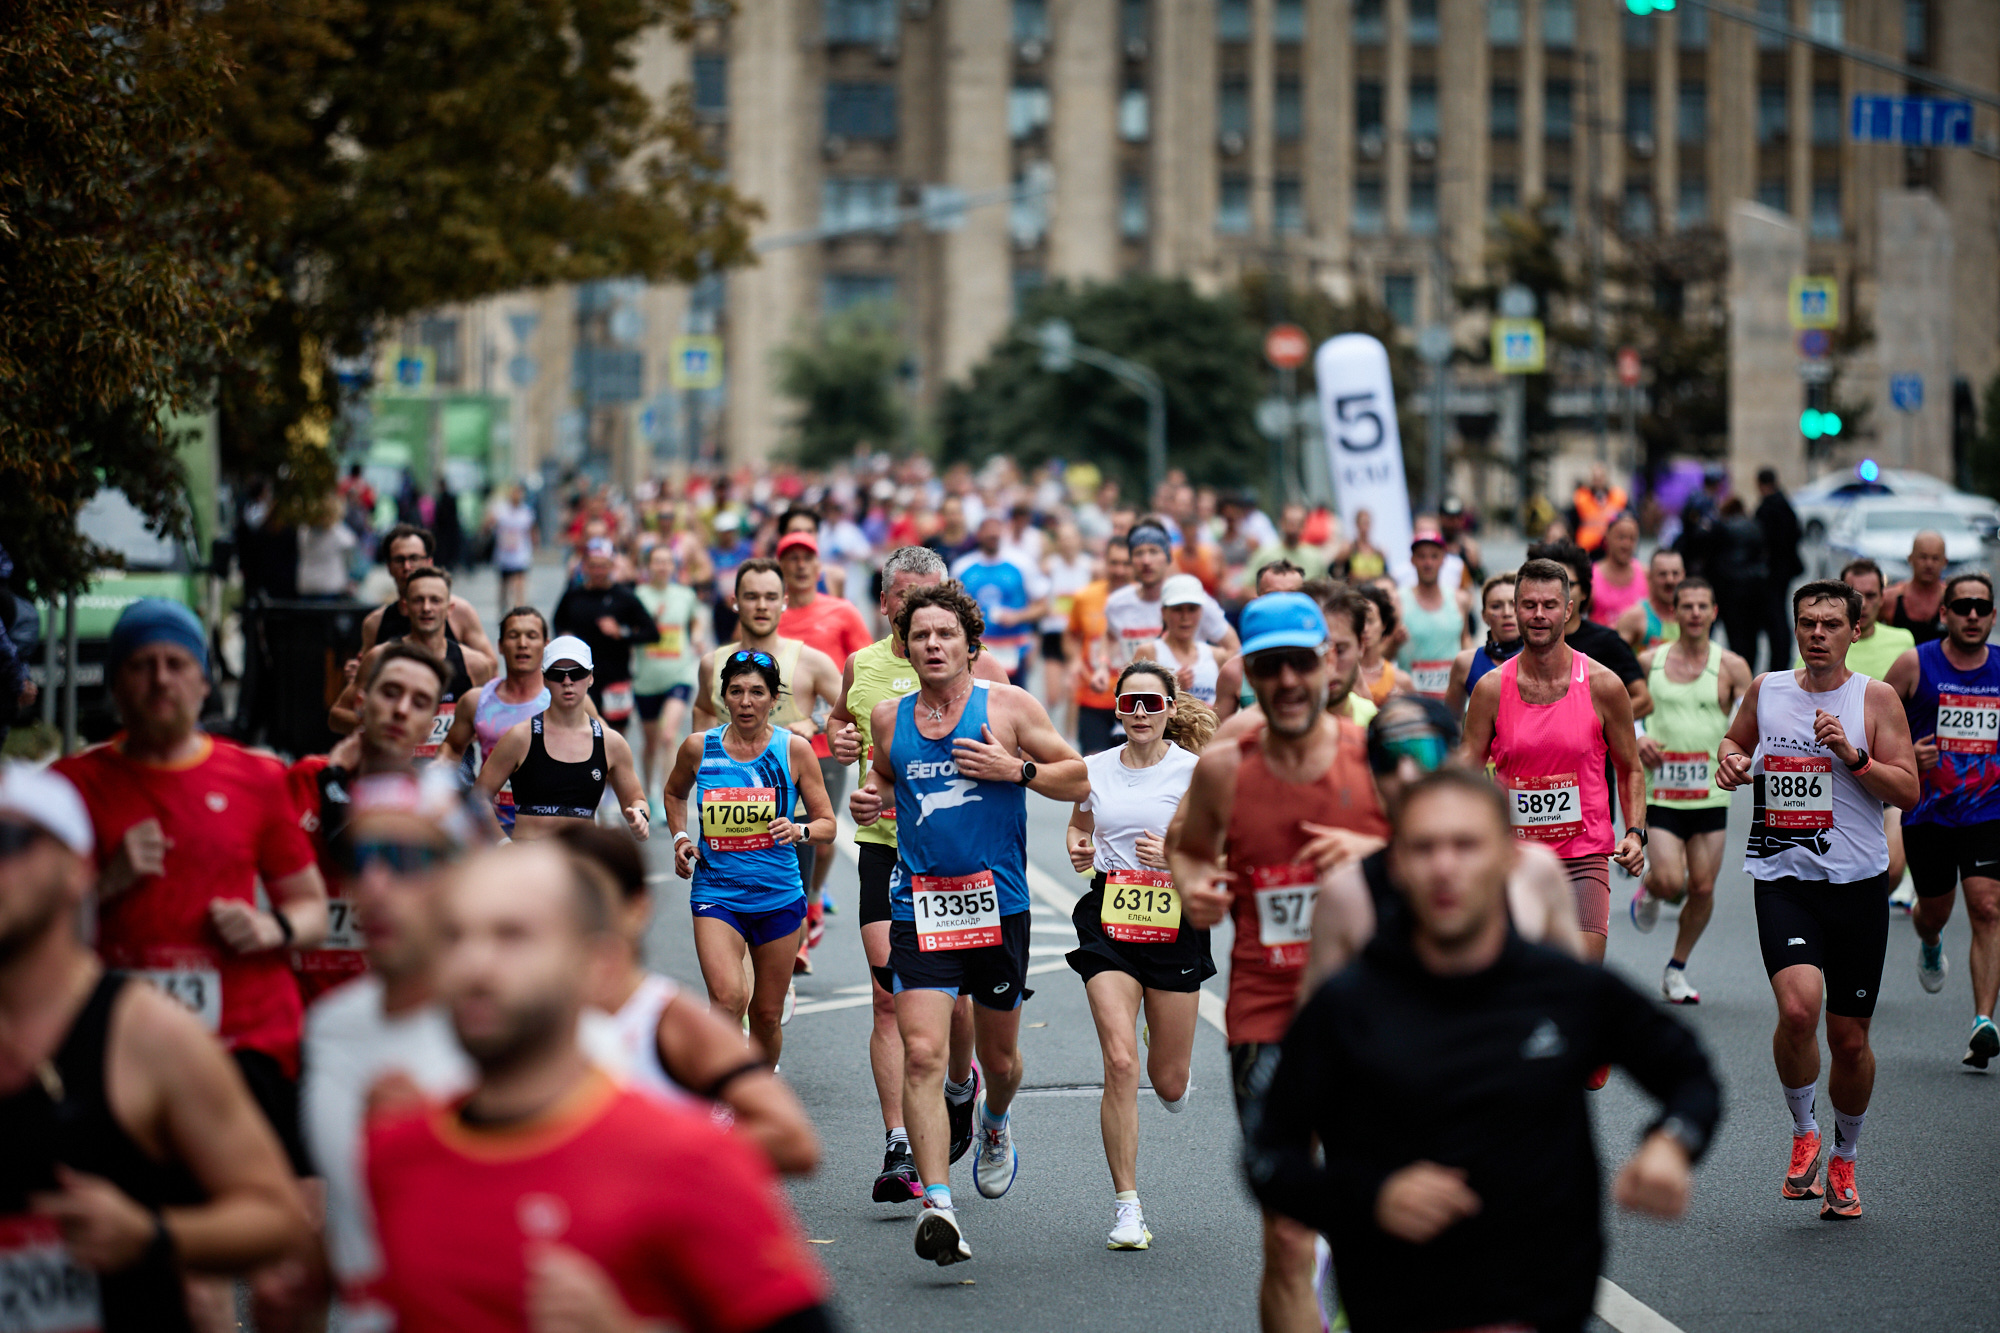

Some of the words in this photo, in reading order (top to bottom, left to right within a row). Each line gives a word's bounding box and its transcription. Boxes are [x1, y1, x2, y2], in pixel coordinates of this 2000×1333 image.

[1336, 390, 1384, 452] 5
[1940, 709, 1998, 730] 22813
[1659, 764, 1708, 781] 11513
[1549, 782, 1559, 790] 10
[1560, 780, 1573, 788] KM
[1770, 776, 1822, 797] 3886
[1517, 791, 1571, 814] 5892
[706, 805, 773, 825] 17054
[1528, 813, 1562, 823] ДМИТРИЙ
[1769, 813, 1776, 826] B
[725, 826, 754, 834] ЛЮБОВЬ
[710, 838, 720, 850] B
[962, 883, 973, 891] 10
[974, 879, 989, 889] KM
[1152, 879, 1162, 887] 10
[919, 890, 995, 918] 13355
[1113, 888, 1172, 914] 6313
[936, 917, 981, 928] АЛЕКСАНДР
[1128, 913, 1152, 922] ЕЛЕНА
[1107, 925, 1116, 939] B
[925, 935, 938, 950] B
